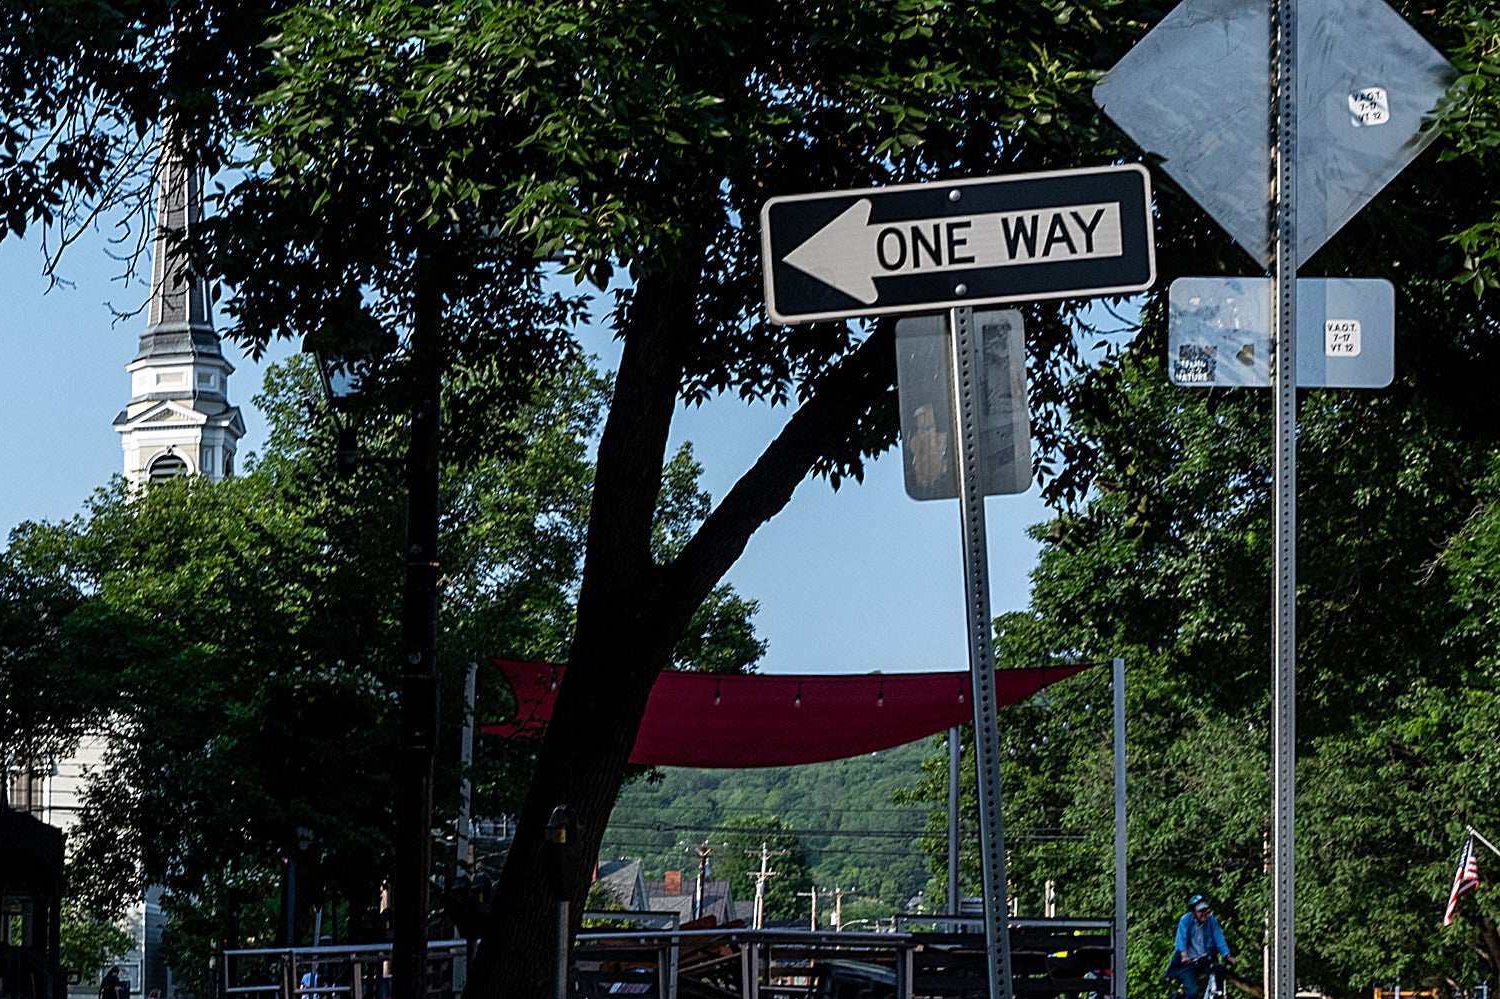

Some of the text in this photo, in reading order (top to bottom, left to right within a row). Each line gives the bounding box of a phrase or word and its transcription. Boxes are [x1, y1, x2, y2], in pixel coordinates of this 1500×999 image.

[876, 208, 1105, 271] ONE WAY
[1333, 333, 1351, 342] 7-17
[1331, 343, 1354, 352] VT 12
